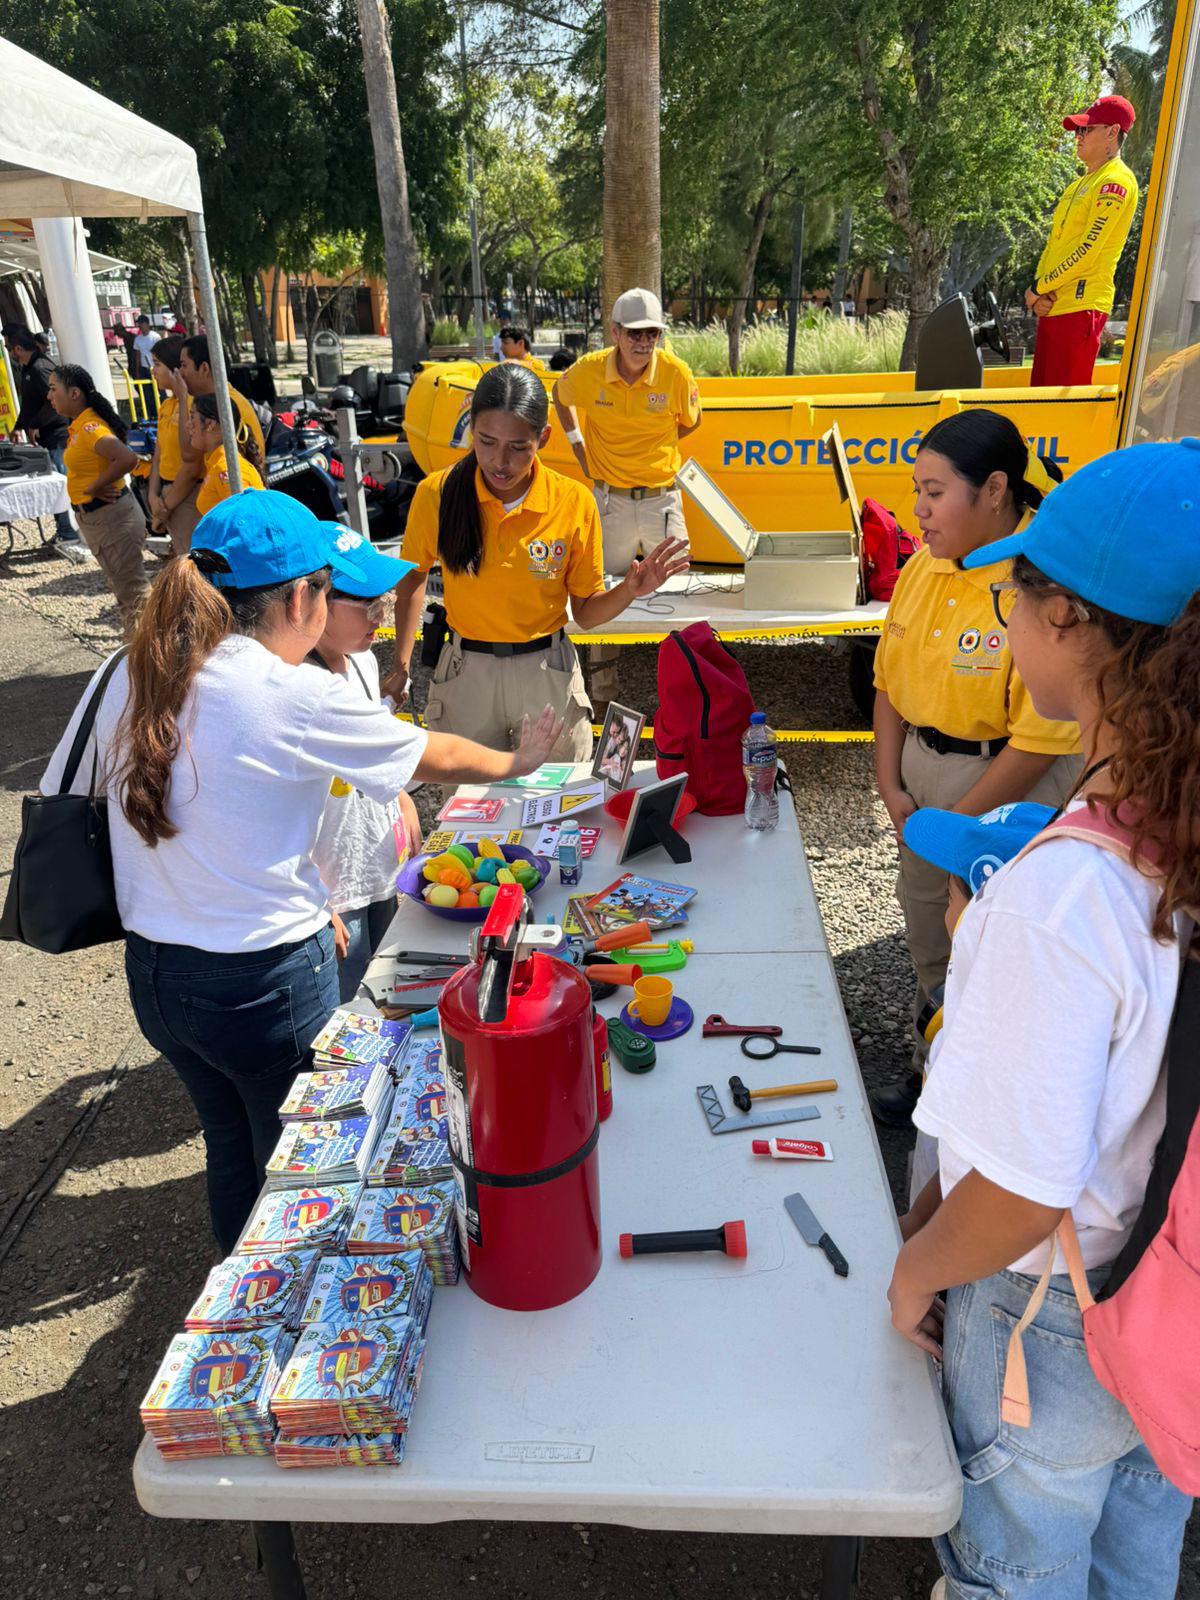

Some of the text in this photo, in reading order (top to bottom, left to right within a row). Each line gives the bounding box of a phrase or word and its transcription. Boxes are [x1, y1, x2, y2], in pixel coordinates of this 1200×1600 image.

[1102, 184, 1125, 197] 911
[1087, 215, 1109, 242] CIVIL
[724, 430, 924, 466] PROTECCIÓ
[783, 1141, 818, 1152] Colgate
